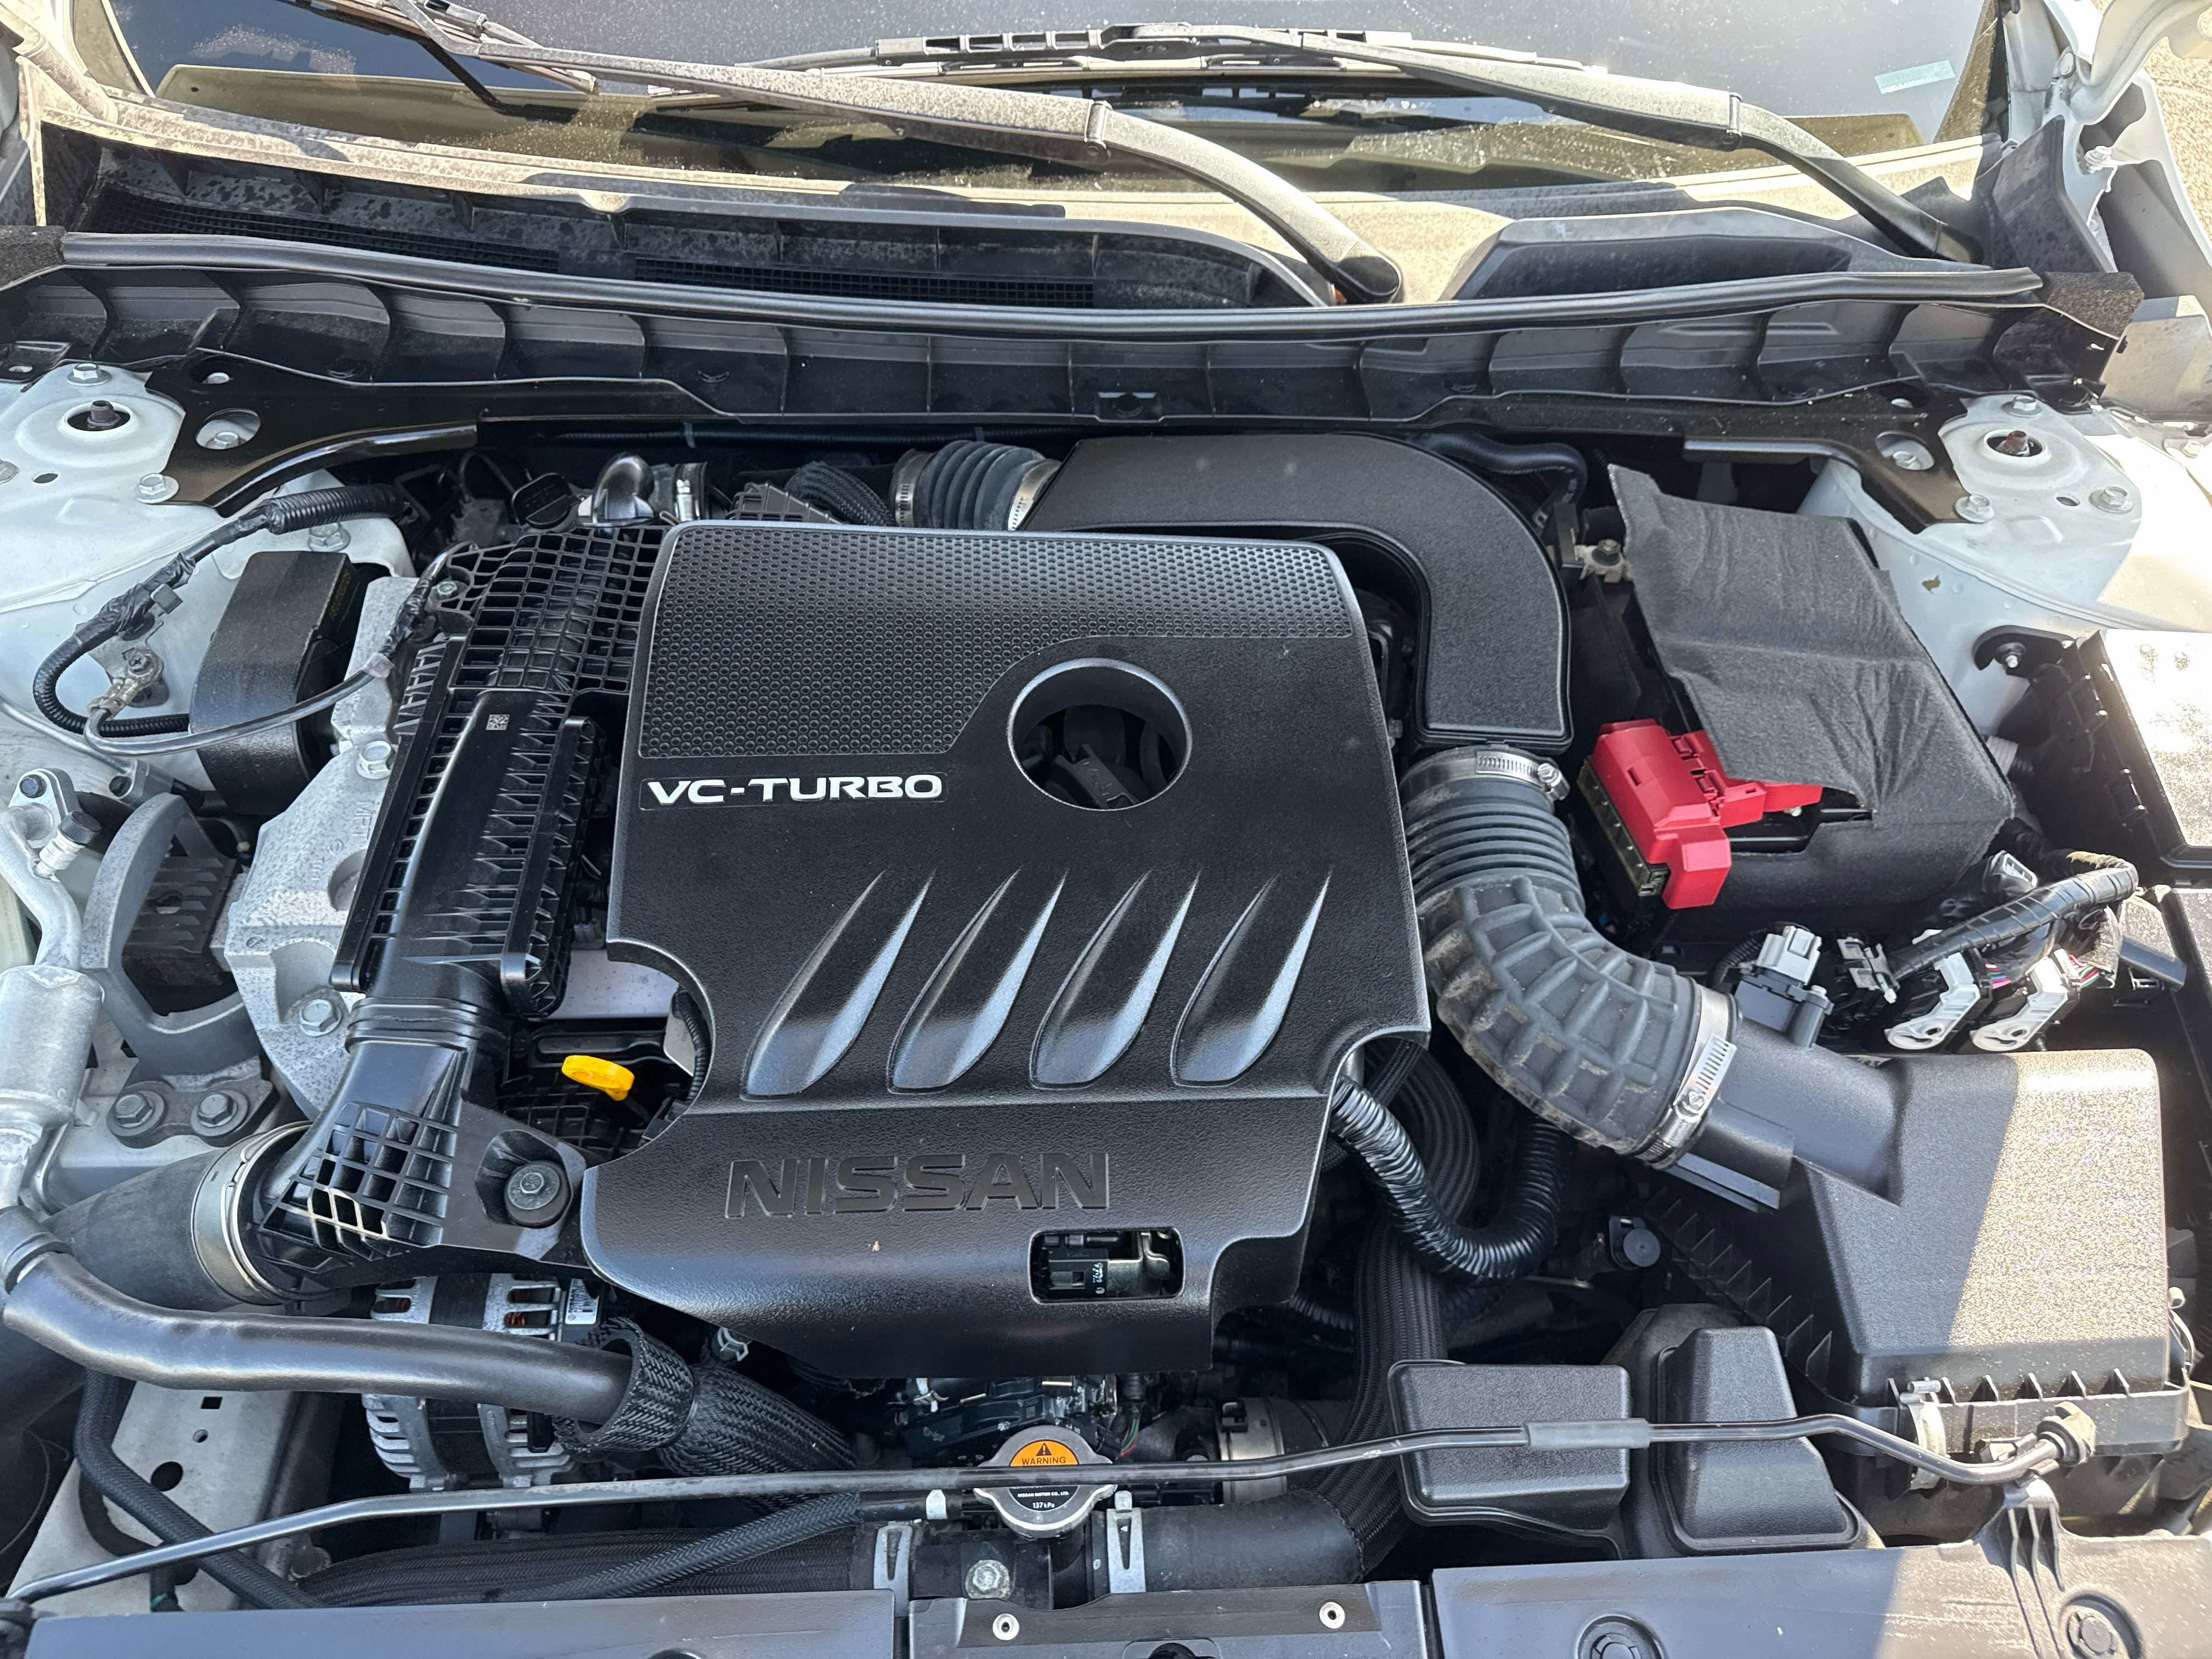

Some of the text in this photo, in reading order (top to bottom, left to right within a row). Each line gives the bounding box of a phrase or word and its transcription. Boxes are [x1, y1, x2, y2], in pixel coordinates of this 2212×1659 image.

[647, 774, 942, 805] VC-TURBO
[725, 1153, 1110, 1218] NISSAN
[1022, 1457, 1066, 1465] WARNING
